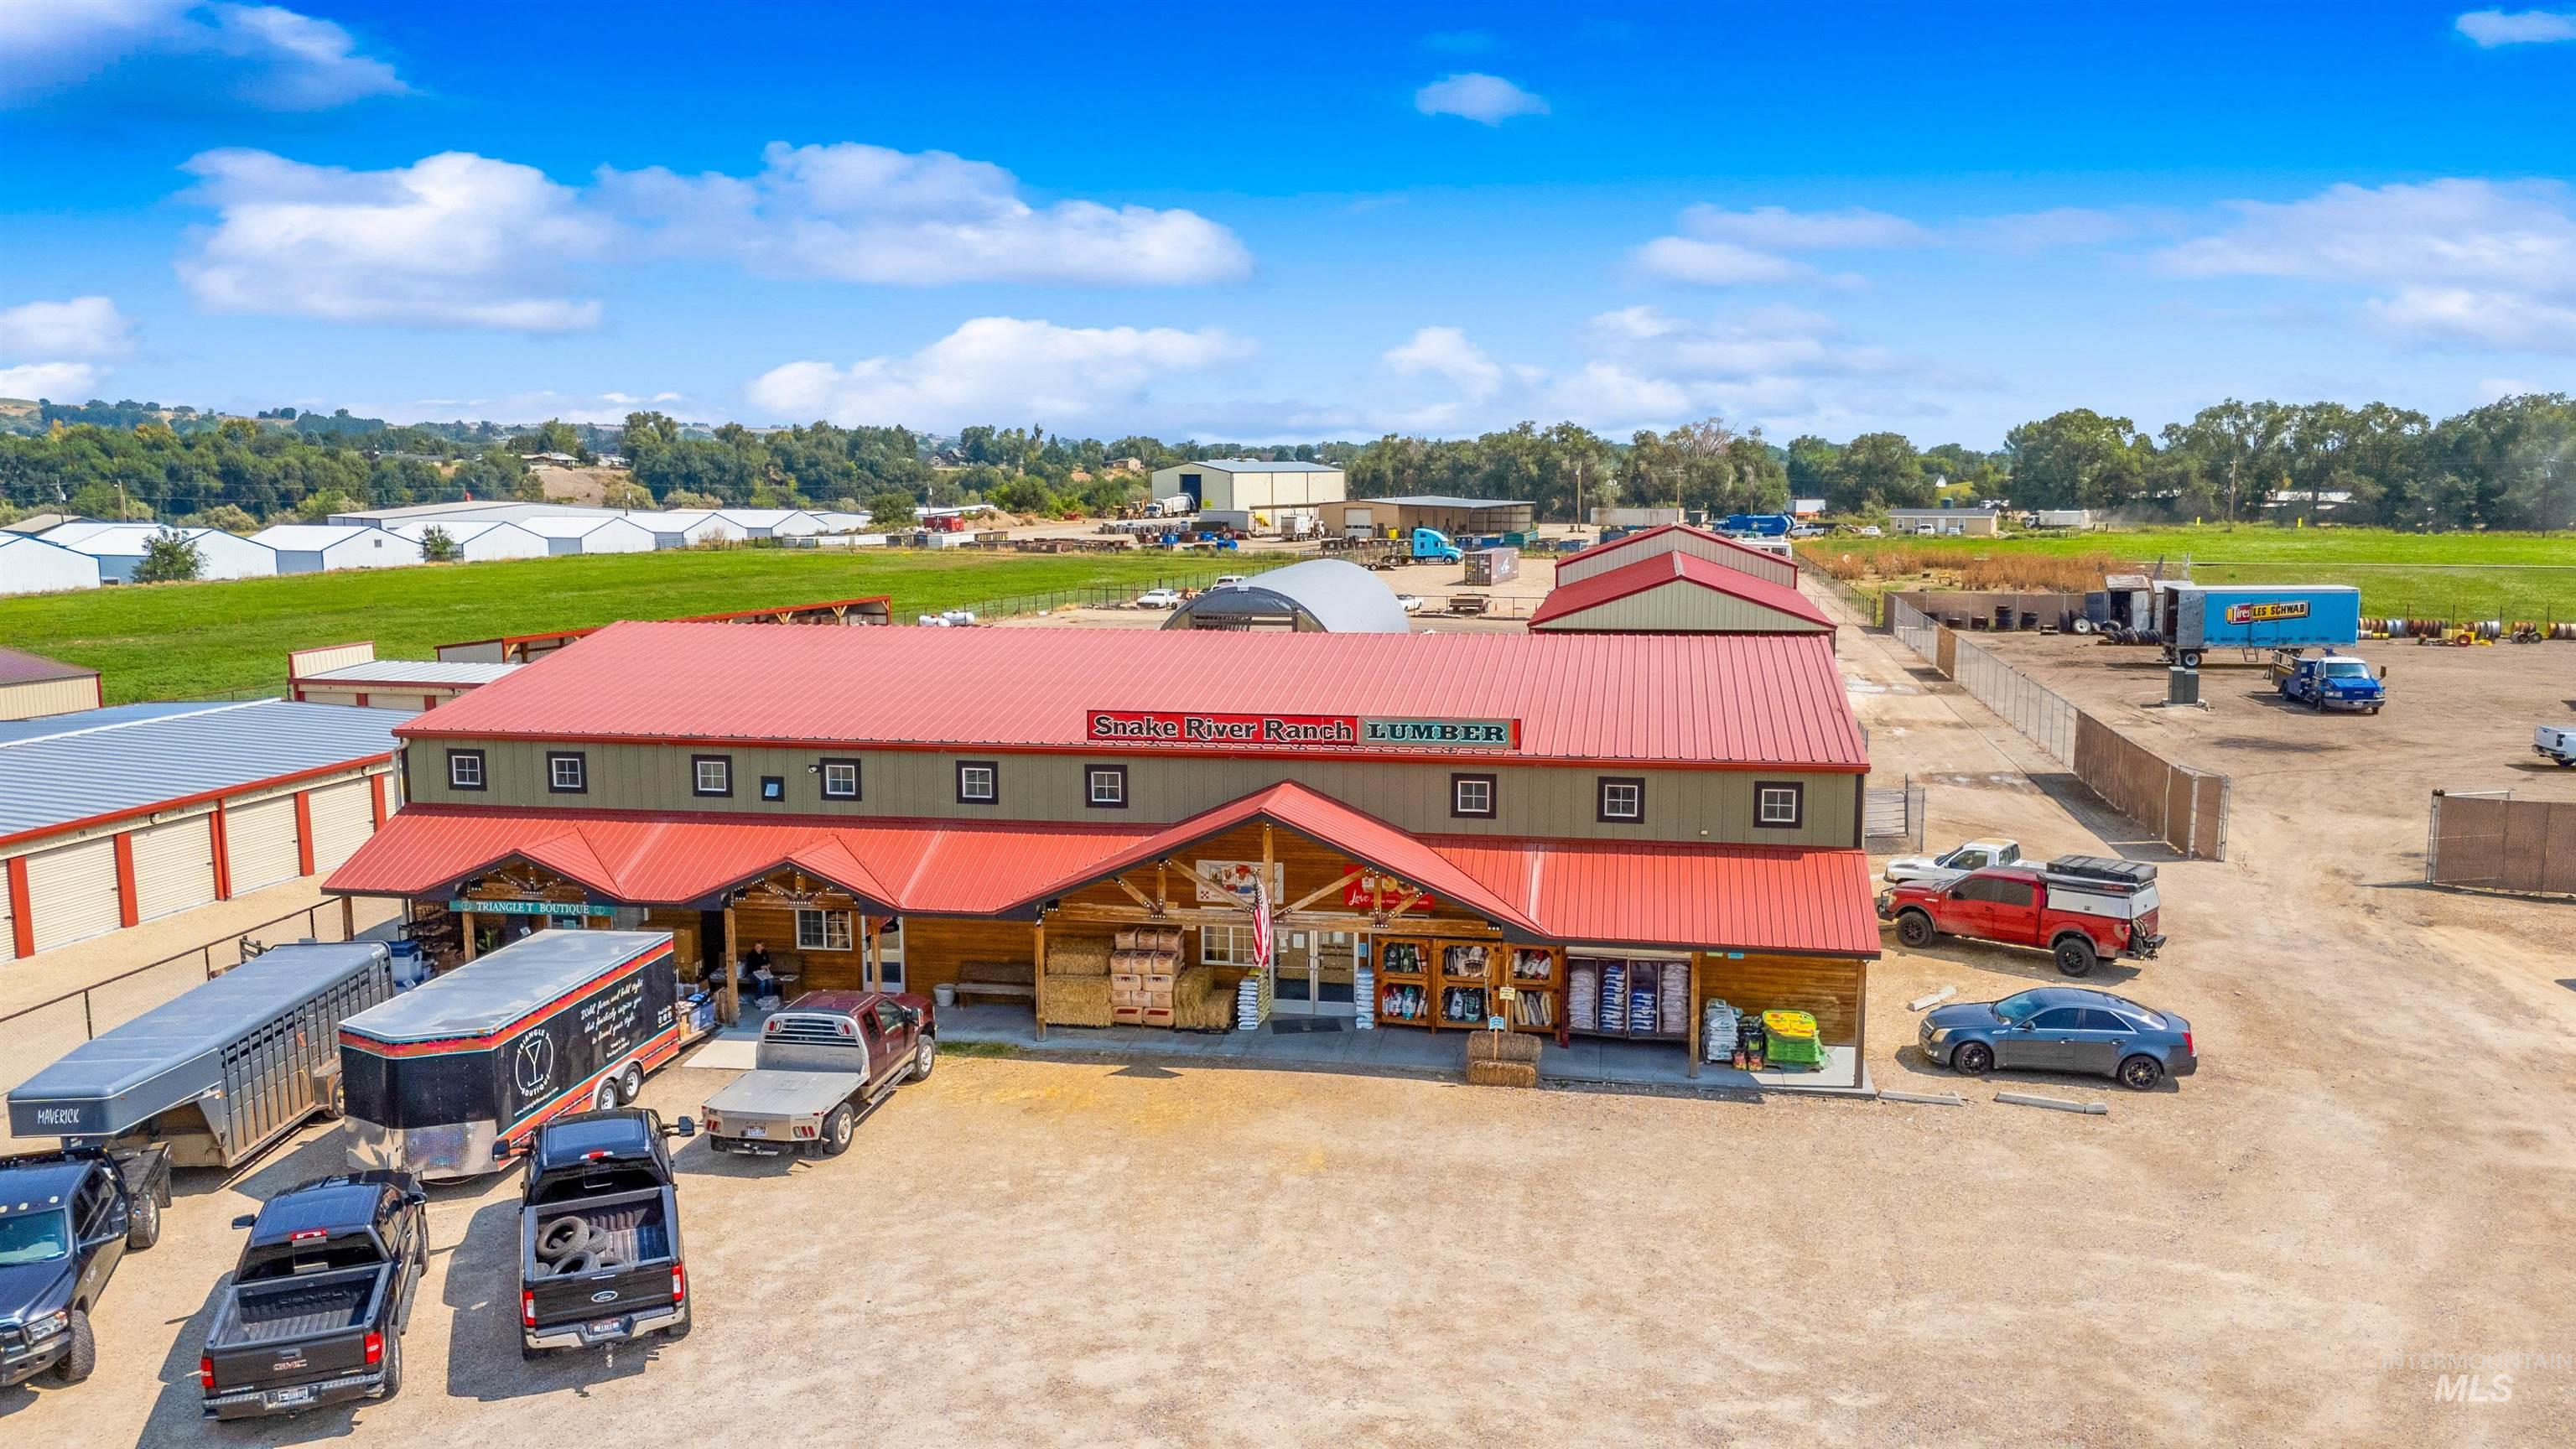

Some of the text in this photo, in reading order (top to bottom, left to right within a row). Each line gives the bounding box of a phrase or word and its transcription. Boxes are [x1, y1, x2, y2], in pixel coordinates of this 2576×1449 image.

[2233, 604, 2305, 621] Tires LES SCHWAB
[1093, 716, 1353, 741] Snake River Ranch
[1368, 723, 1506, 742] LUMBER
[1348, 889, 1368, 906] Love
[476, 901, 589, 915] TRIANGLE T BOUTIQUE
[517, 1029, 545, 1055] TRIANGLE
[38, 1108, 80, 1124] MAVERICK
[273, 1359, 308, 1371] GMC
